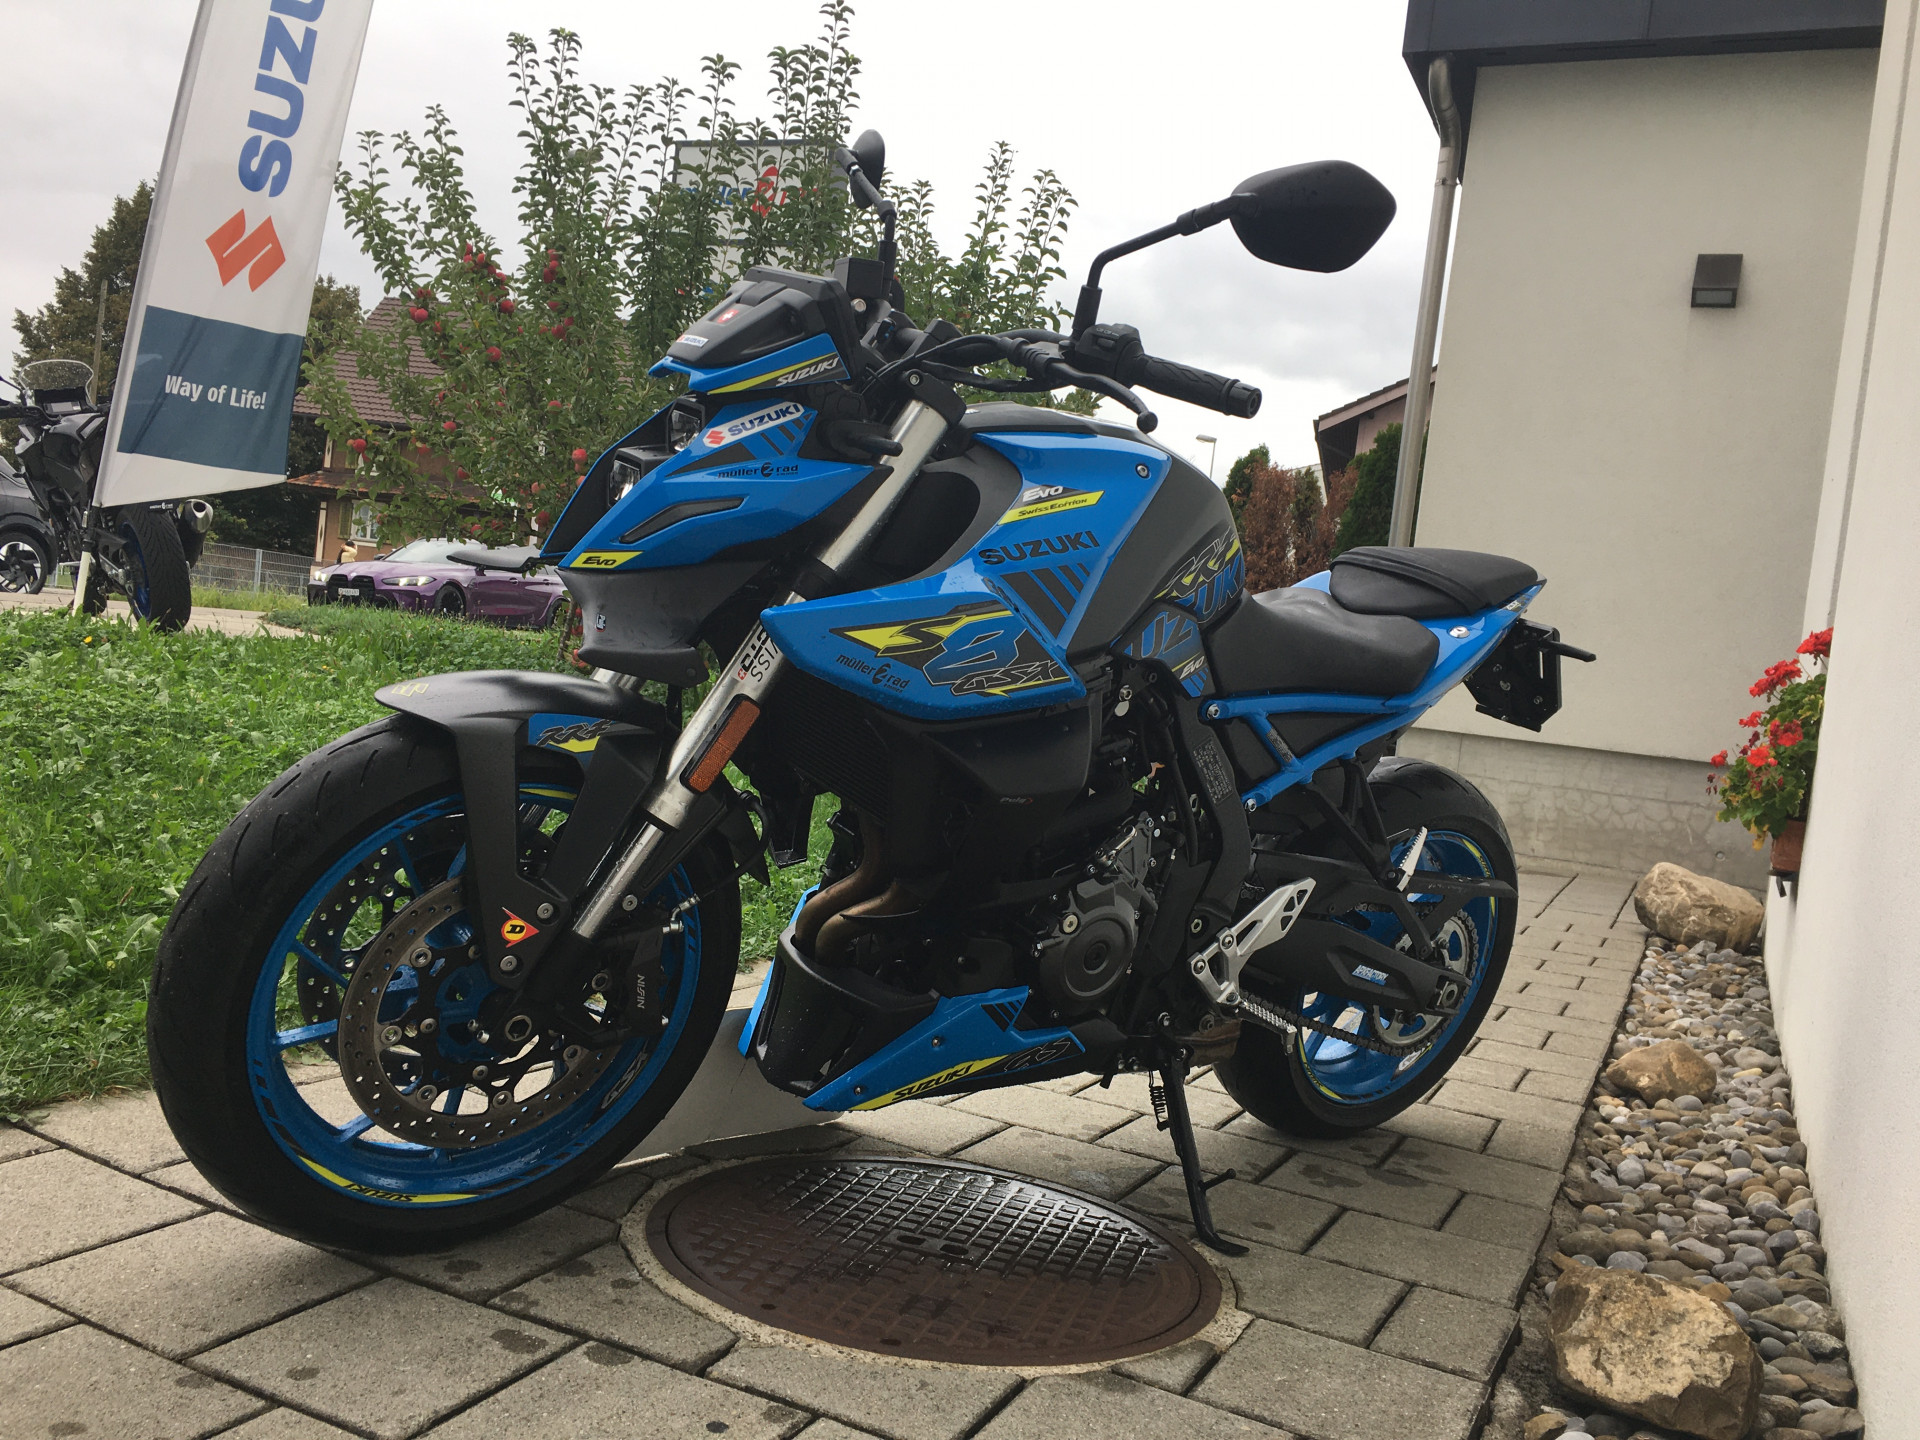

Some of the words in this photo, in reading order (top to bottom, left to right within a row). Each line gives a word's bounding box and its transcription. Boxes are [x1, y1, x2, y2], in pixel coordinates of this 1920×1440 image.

[776, 357, 839, 387] SUZUKI
[165, 375, 203, 402] Way
[207, 385, 227, 403] of
[230, 388, 267, 409] Life!
[728, 404, 800, 437] SUZUKI
[979, 531, 1099, 565] SUZUKI
[505, 923, 526, 934] D
[892, 1064, 973, 1101] SUZUKI
[344, 1182, 418, 1202] SUZUKI
